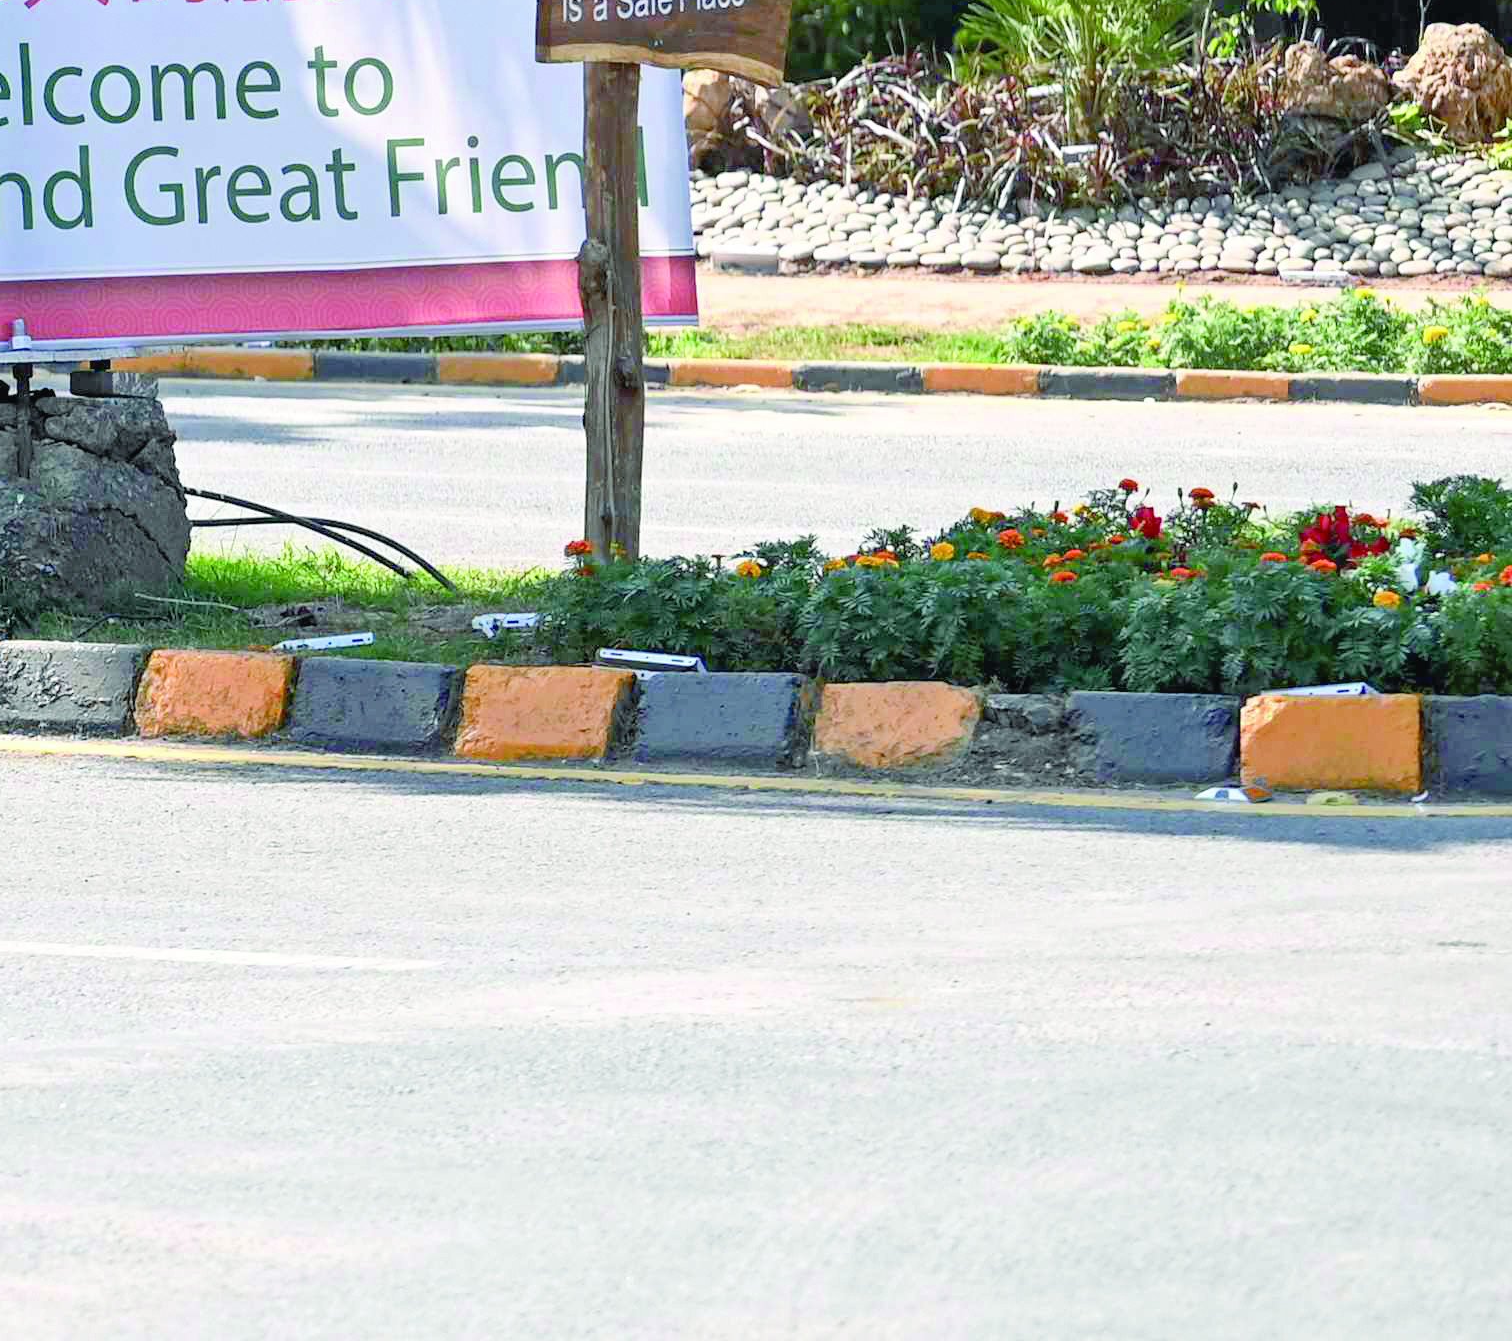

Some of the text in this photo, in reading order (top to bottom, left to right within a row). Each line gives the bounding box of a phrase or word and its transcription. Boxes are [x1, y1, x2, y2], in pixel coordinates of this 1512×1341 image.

[307, 44, 394, 118] to
[123, 145, 358, 226] Great
[386, 125, 649, 218] Frien
